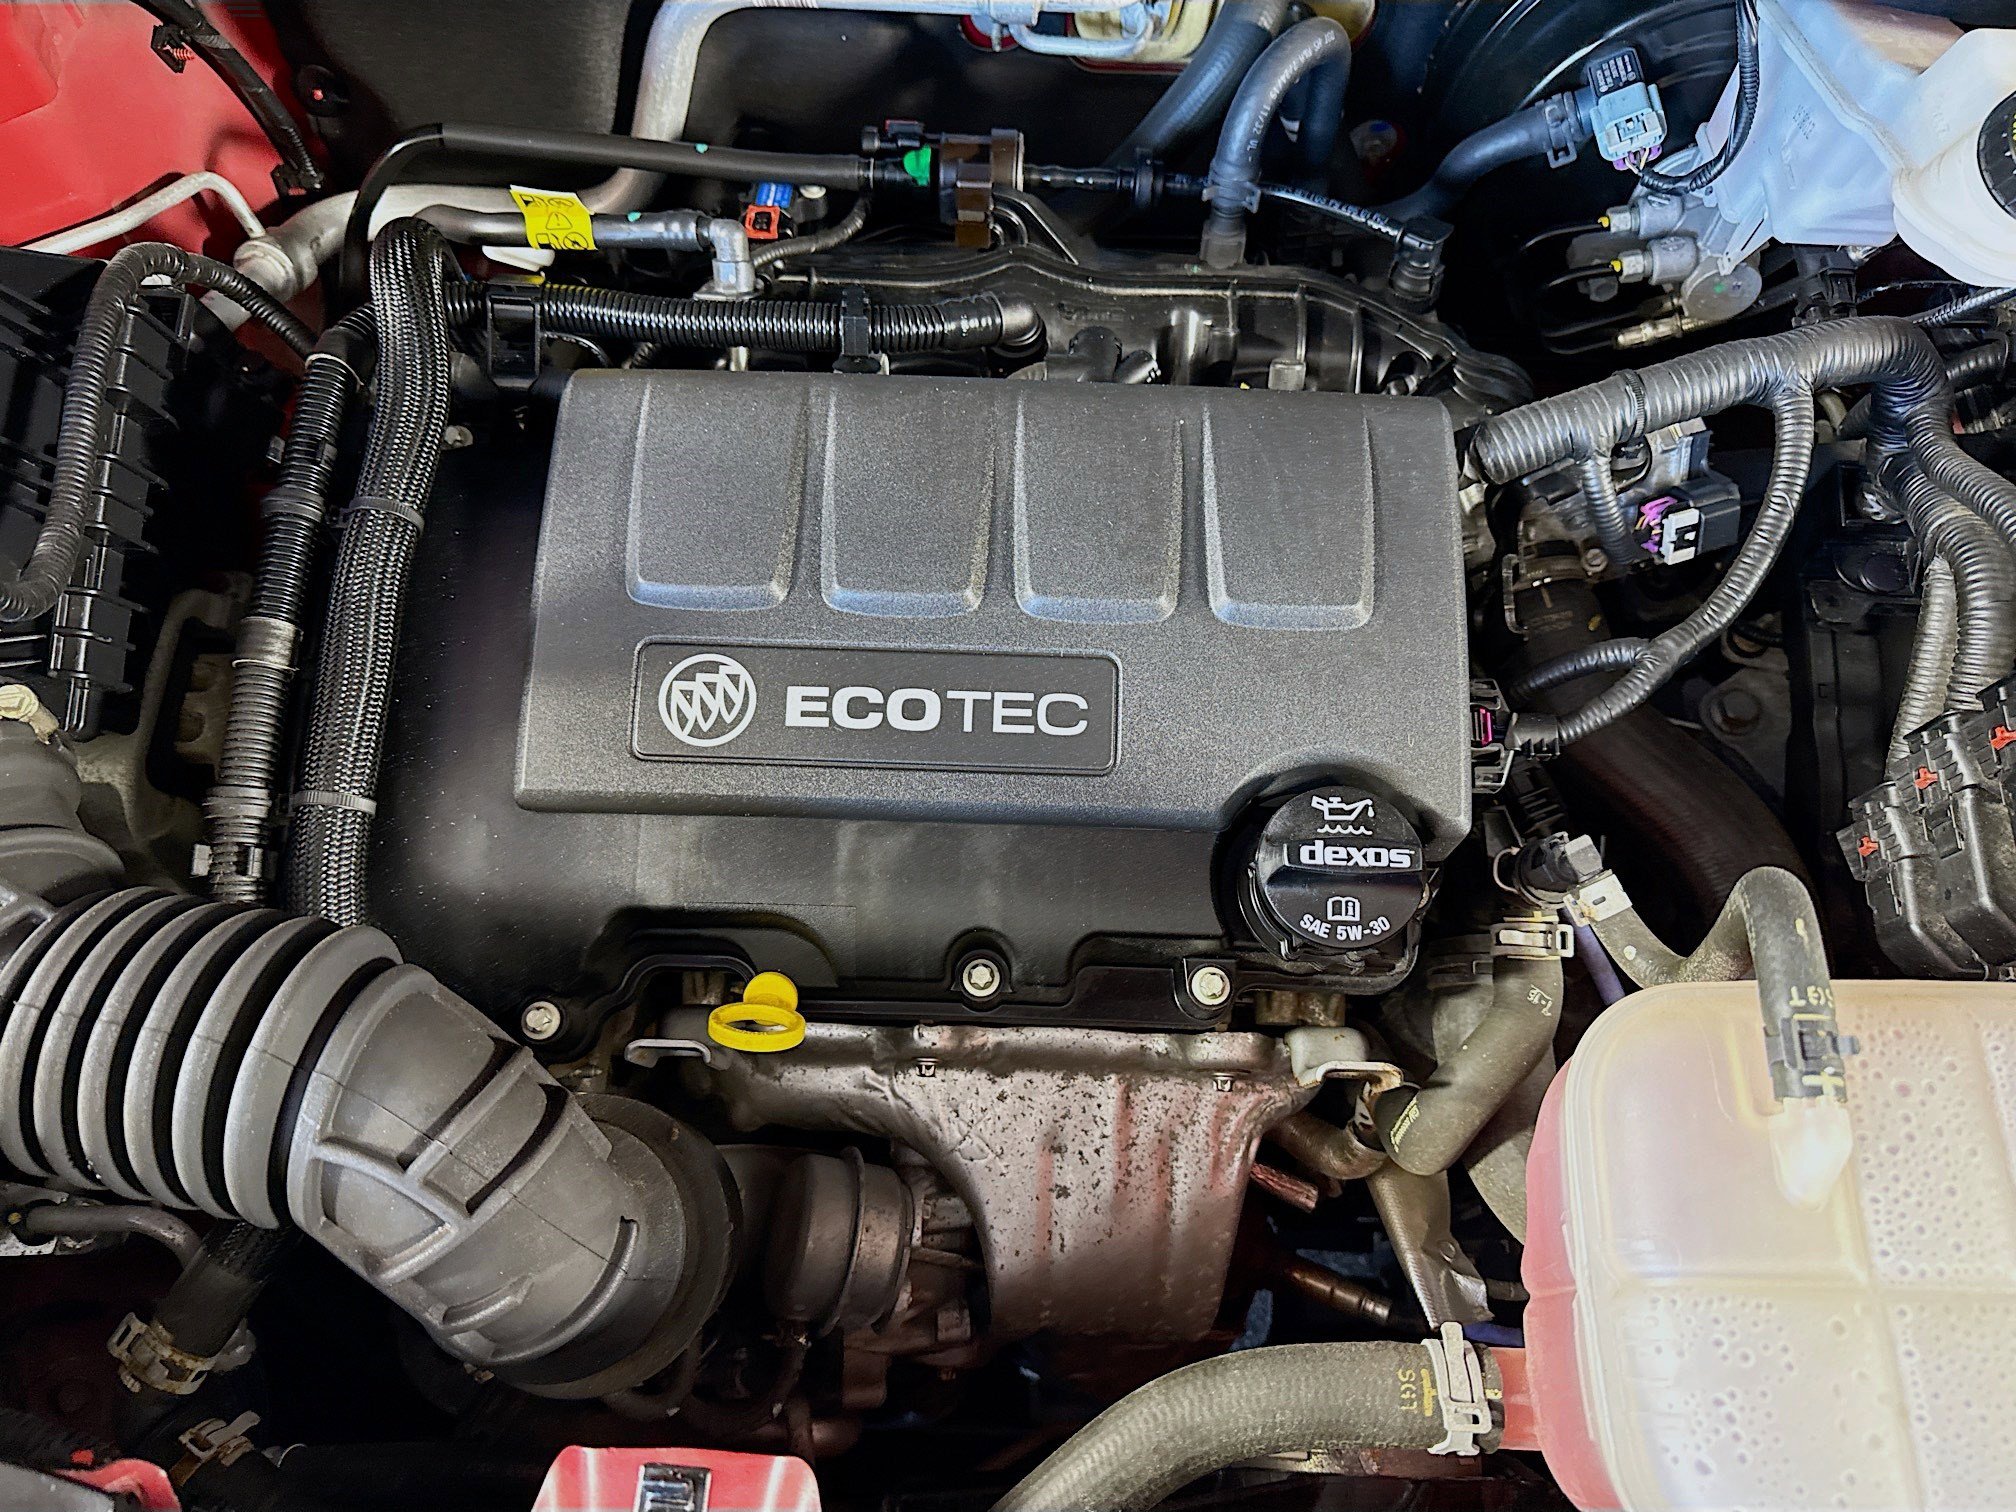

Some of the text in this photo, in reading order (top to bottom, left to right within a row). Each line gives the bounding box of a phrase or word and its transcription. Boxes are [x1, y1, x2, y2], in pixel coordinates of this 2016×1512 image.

[785, 684, 1089, 738] ECOTEC
[1299, 839, 1412, 868] dexos
[1299, 913, 1391, 941] SAE 5W-30
